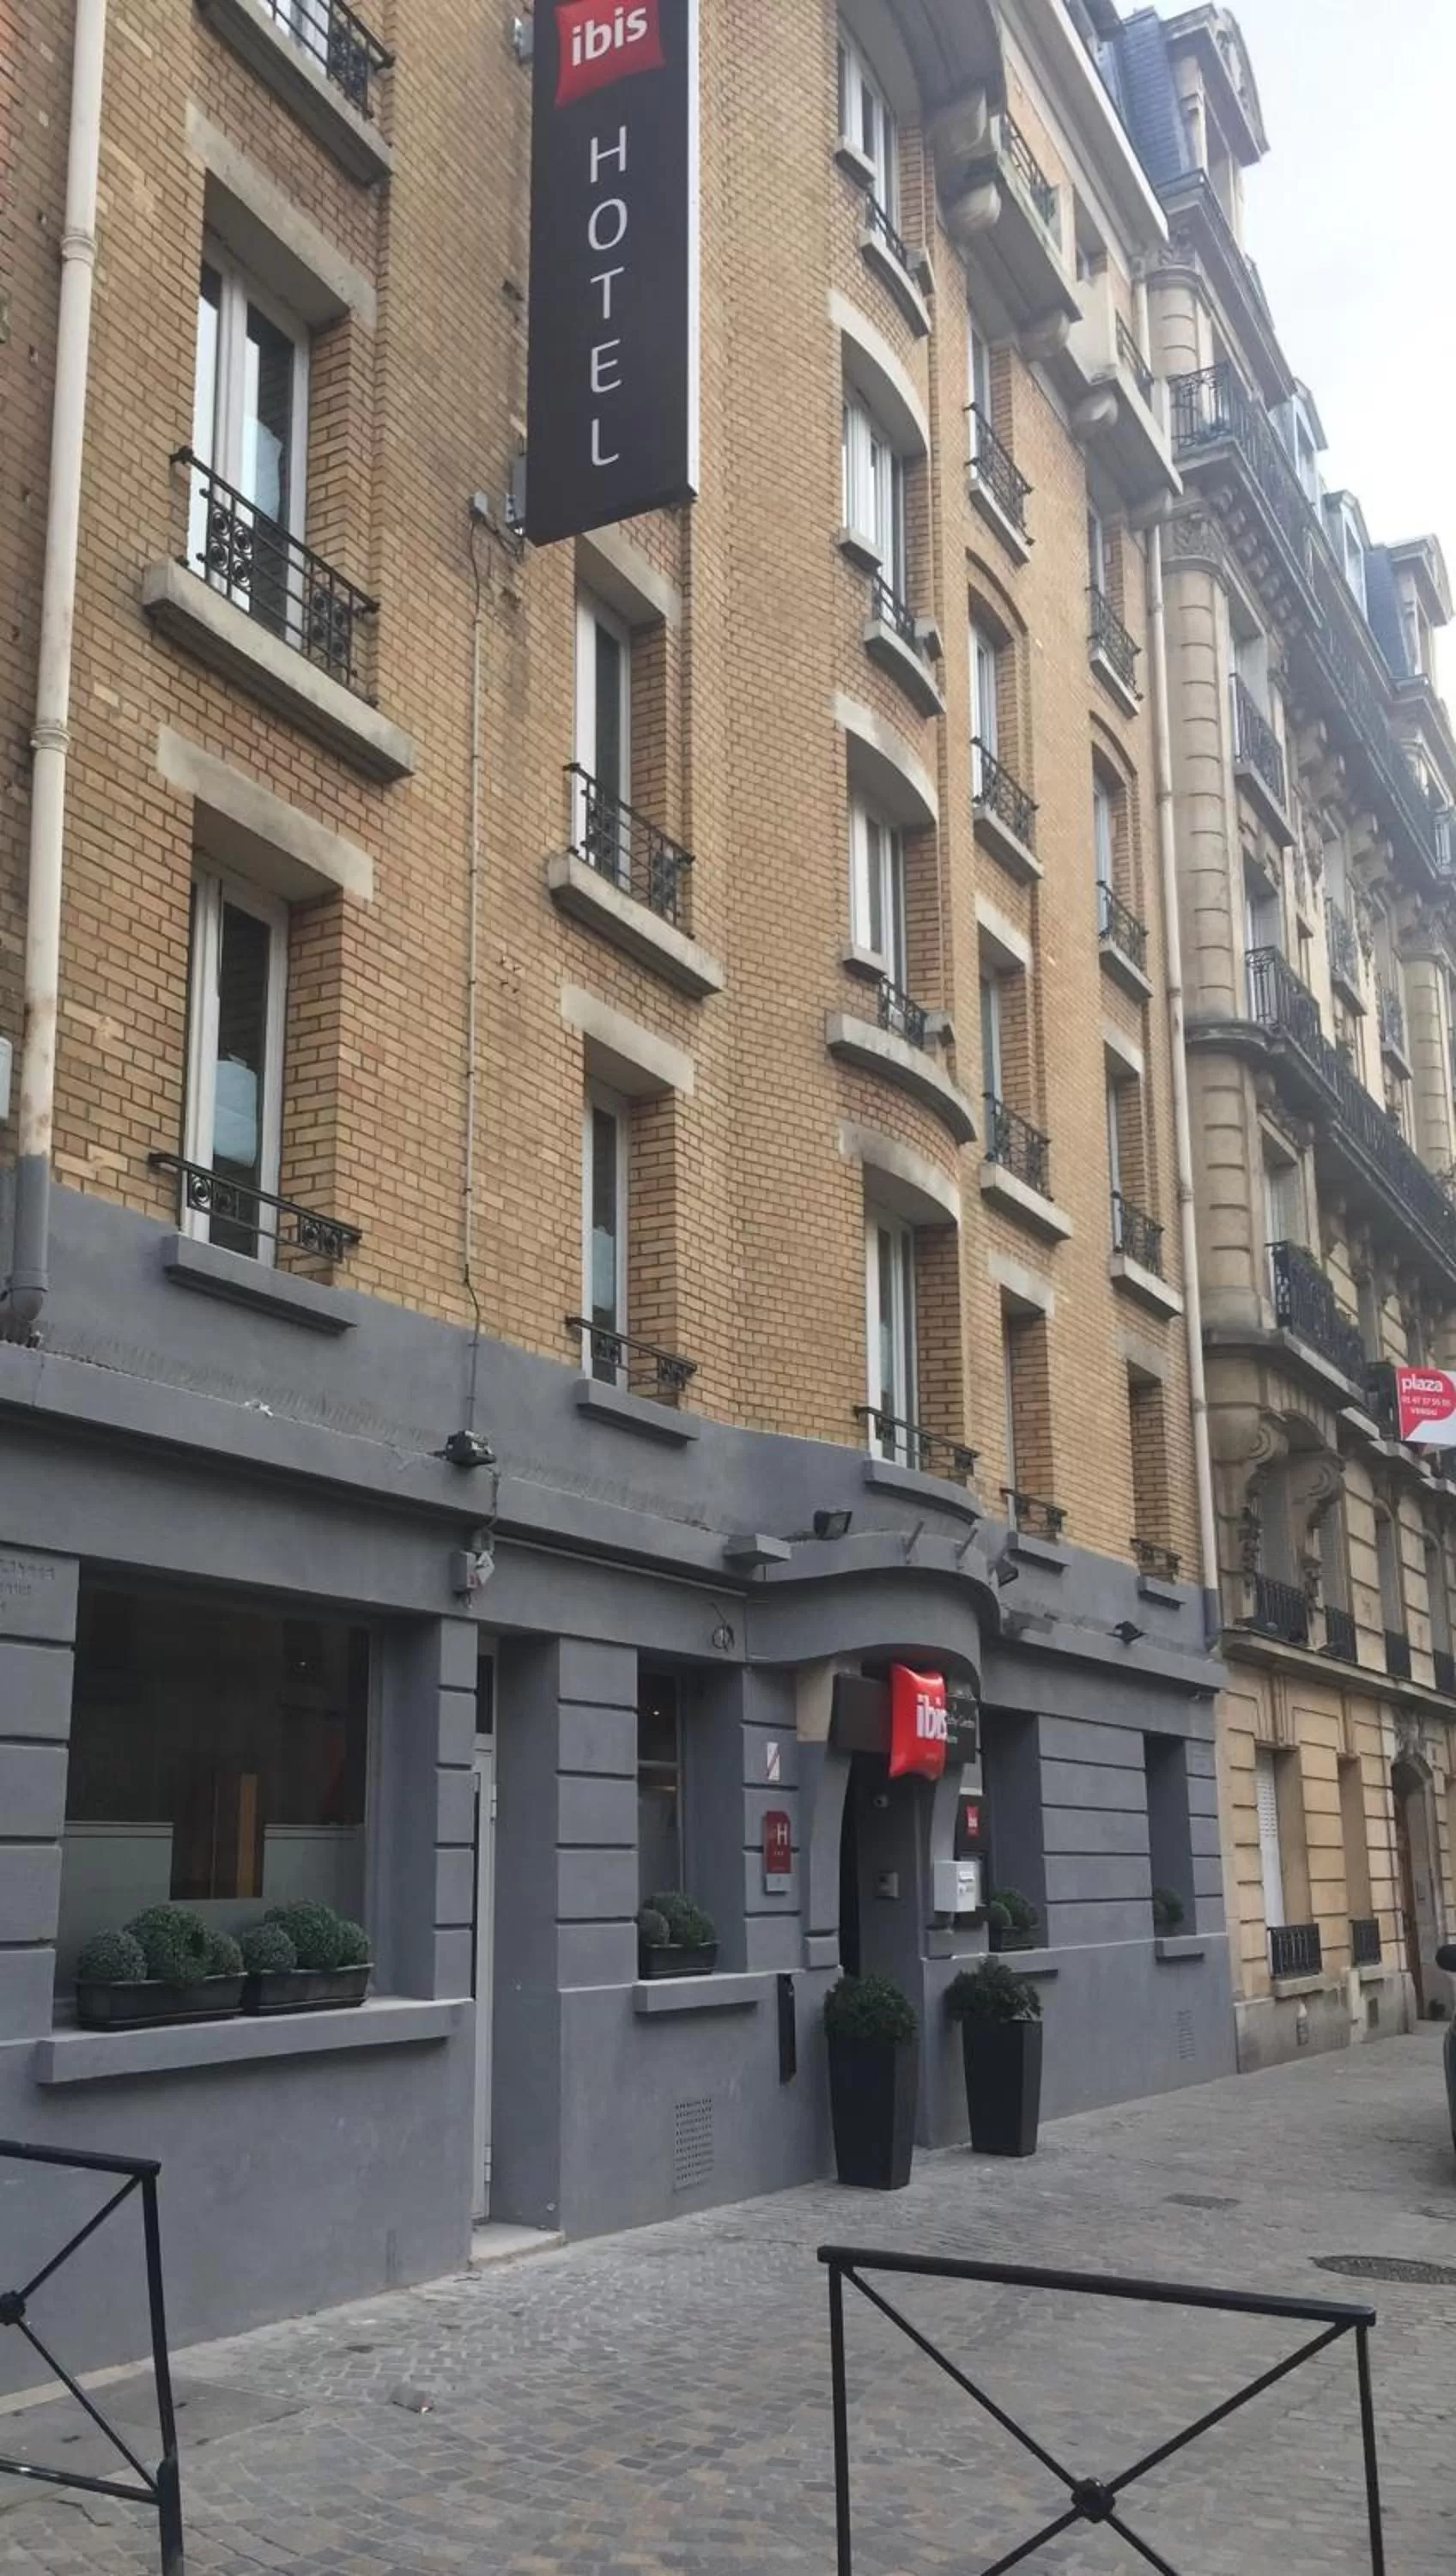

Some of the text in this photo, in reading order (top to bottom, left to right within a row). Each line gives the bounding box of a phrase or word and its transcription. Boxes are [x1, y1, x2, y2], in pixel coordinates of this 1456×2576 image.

[572, 7, 647, 66] ibis
[587, 125, 628, 466] HOTEL
[1401, 1374, 1443, 1393] plaza
[916, 1693, 948, 1741] ibis
[777, 1822, 787, 1845] H
